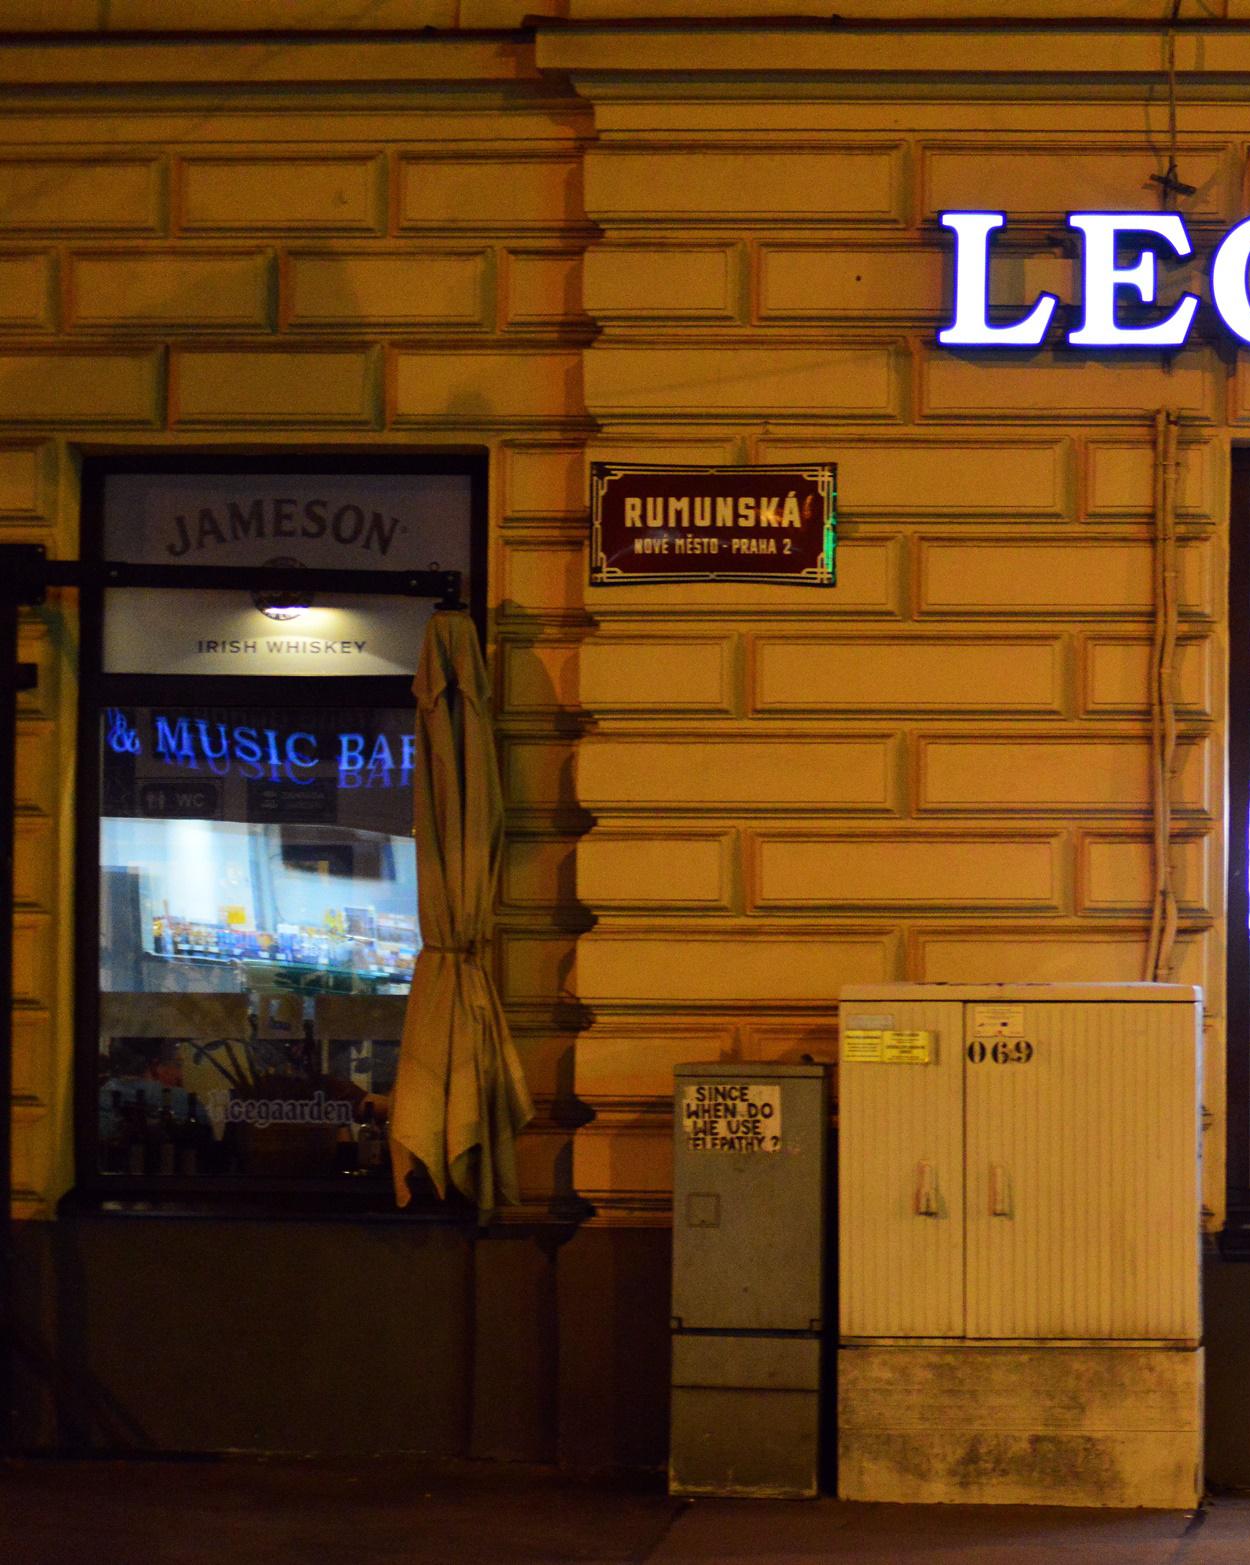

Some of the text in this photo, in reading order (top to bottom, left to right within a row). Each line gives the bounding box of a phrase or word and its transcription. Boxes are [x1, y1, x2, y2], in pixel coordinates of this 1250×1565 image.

[624, 491, 801, 528] RUMUNSKÁ
[634, 534, 669, 554] NOVÉ
[675, 534, 719, 554] MĚSTO
[732, 538, 777, 554] PRAHA
[783, 538, 792, 554] 2
[198, 640, 368, 654] IRISH WHISKEY
[155, 715, 320, 769] MUSIC
[968, 1040, 1034, 1065] 069
[695, 1086, 749, 1102] SINCE
[686, 1102, 774, 1119] WHEN DO
[693, 1119, 762, 1137] WE USE
[687, 1136, 765, 1153] ELEPATHY
